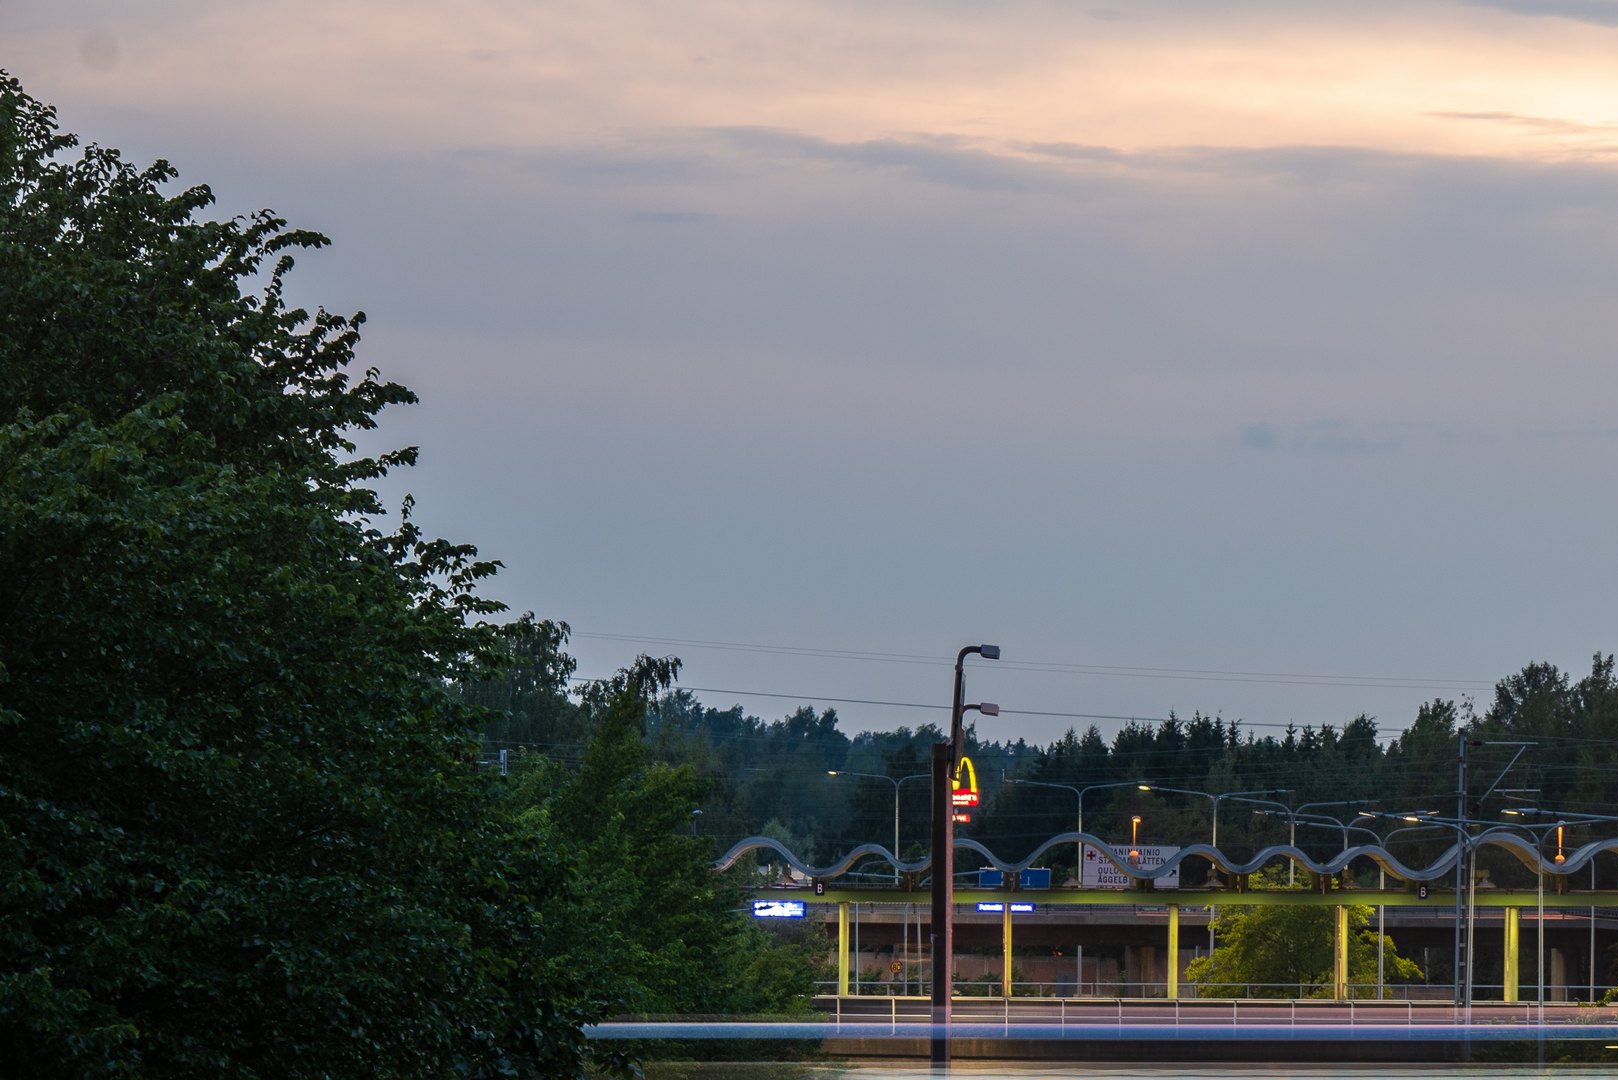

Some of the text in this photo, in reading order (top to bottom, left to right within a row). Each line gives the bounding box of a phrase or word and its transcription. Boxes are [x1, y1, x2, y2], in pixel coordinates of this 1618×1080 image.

[1097, 874, 1128, 883] ÅGGELB
[817, 883, 823, 894] B
[1420, 886, 1426, 897] B
